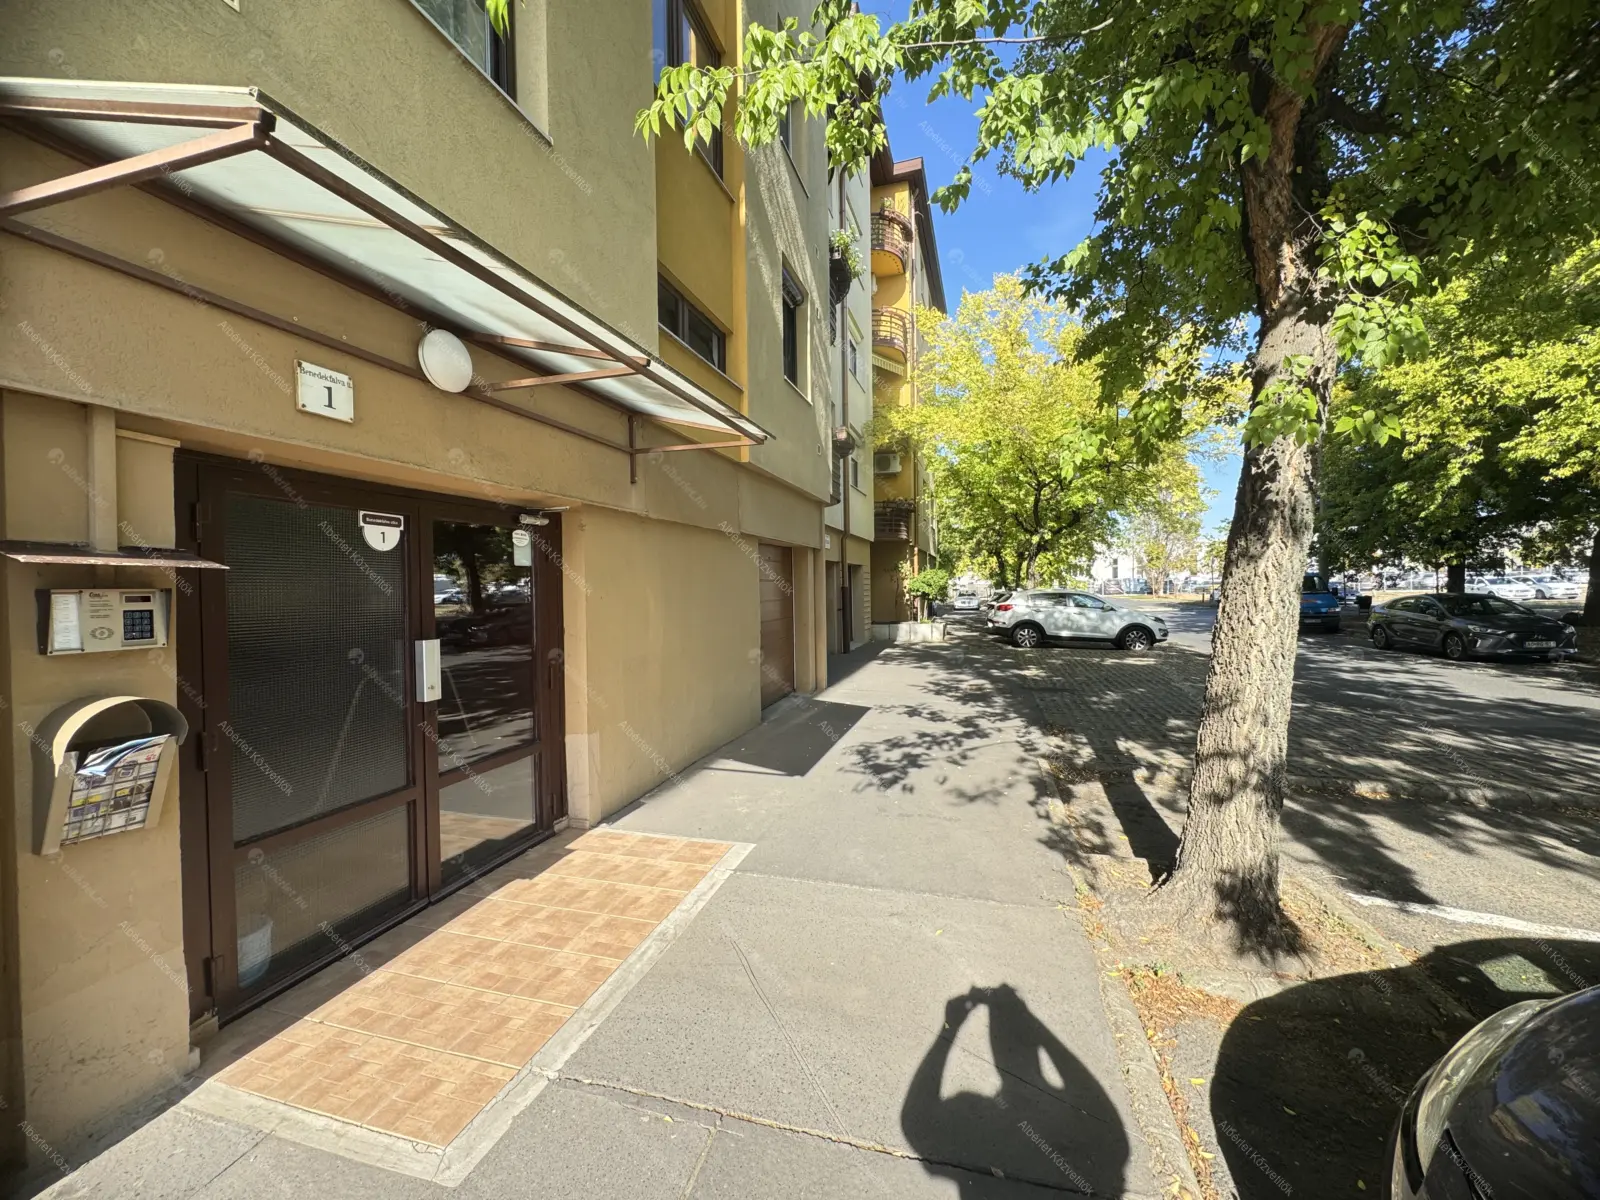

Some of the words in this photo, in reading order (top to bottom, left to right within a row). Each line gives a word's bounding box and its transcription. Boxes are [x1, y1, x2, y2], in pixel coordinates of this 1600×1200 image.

[299, 365, 346, 387] Benedekfalva
[322, 385, 337, 410] 1
[380, 531, 386, 544] 1
